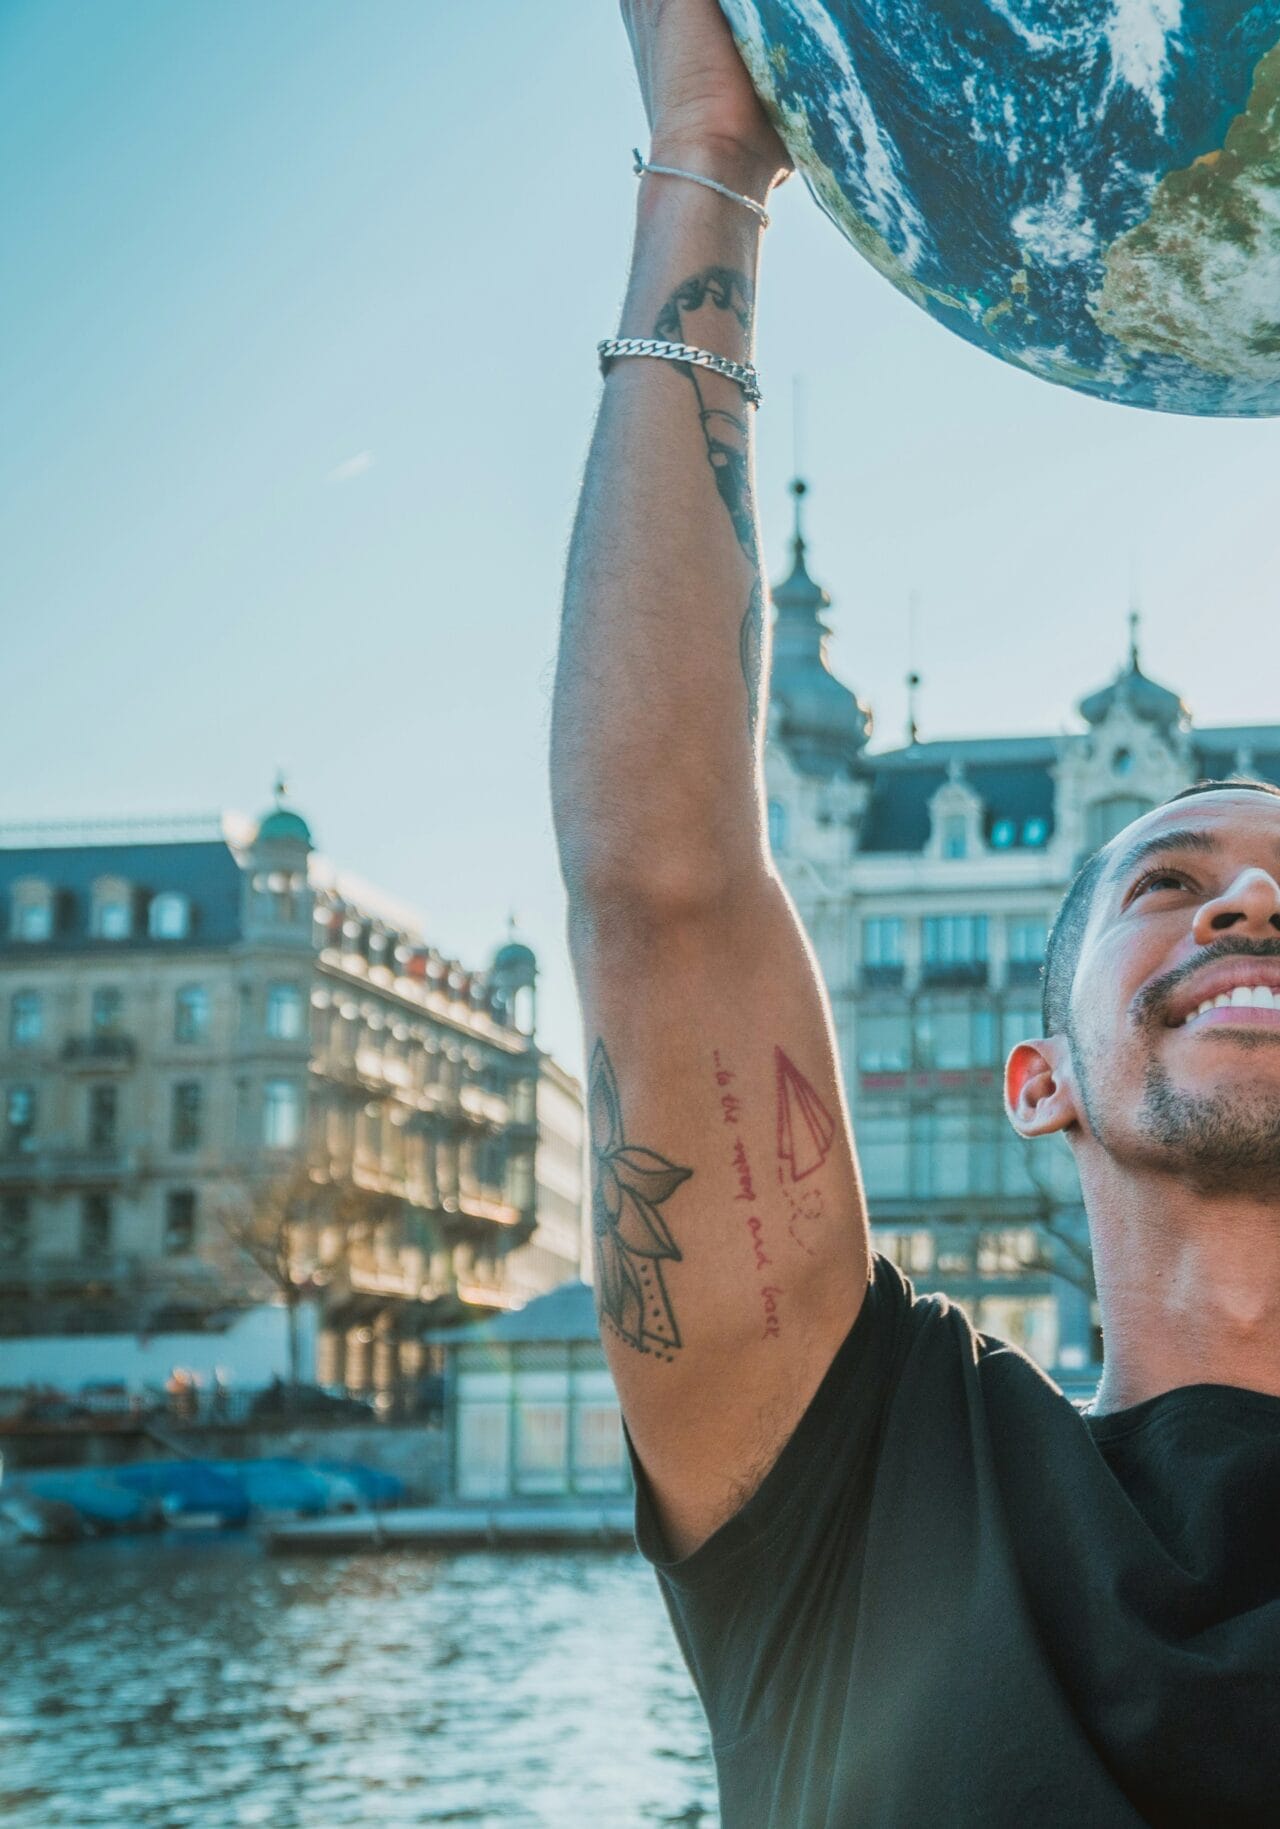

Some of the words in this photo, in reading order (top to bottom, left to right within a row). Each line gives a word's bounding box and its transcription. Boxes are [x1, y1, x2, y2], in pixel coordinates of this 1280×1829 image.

[720, 1094, 739, 1124] the
[747, 1217, 772, 1270] and
[760, 1286, 784, 1340] back
